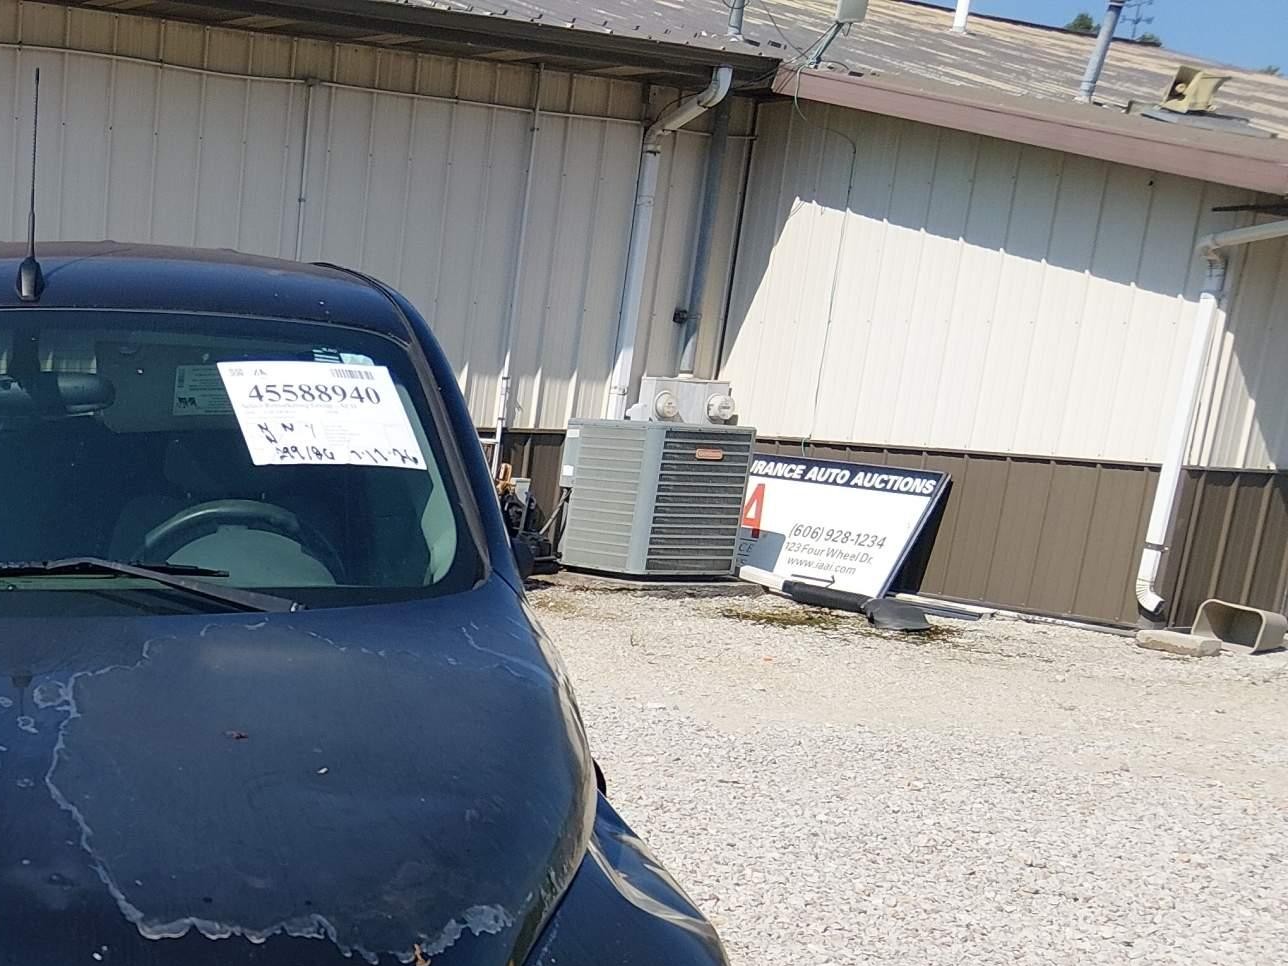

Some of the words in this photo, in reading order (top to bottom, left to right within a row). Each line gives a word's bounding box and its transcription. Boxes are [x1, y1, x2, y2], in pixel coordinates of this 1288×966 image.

[248, 383, 381, 405] 45588940
[804, 466, 850, 485] AUTO
[849, 471, 937, 495] AUCTIONS
[788, 523, 825, 542] (606)
[823, 528, 887, 549] 928-1234
[784, 541, 802, 553] 123
[800, 543, 826, 557] Four
[825, 547, 861, 562] Wheel
[787, 557, 857, 575] www.iaai.com
